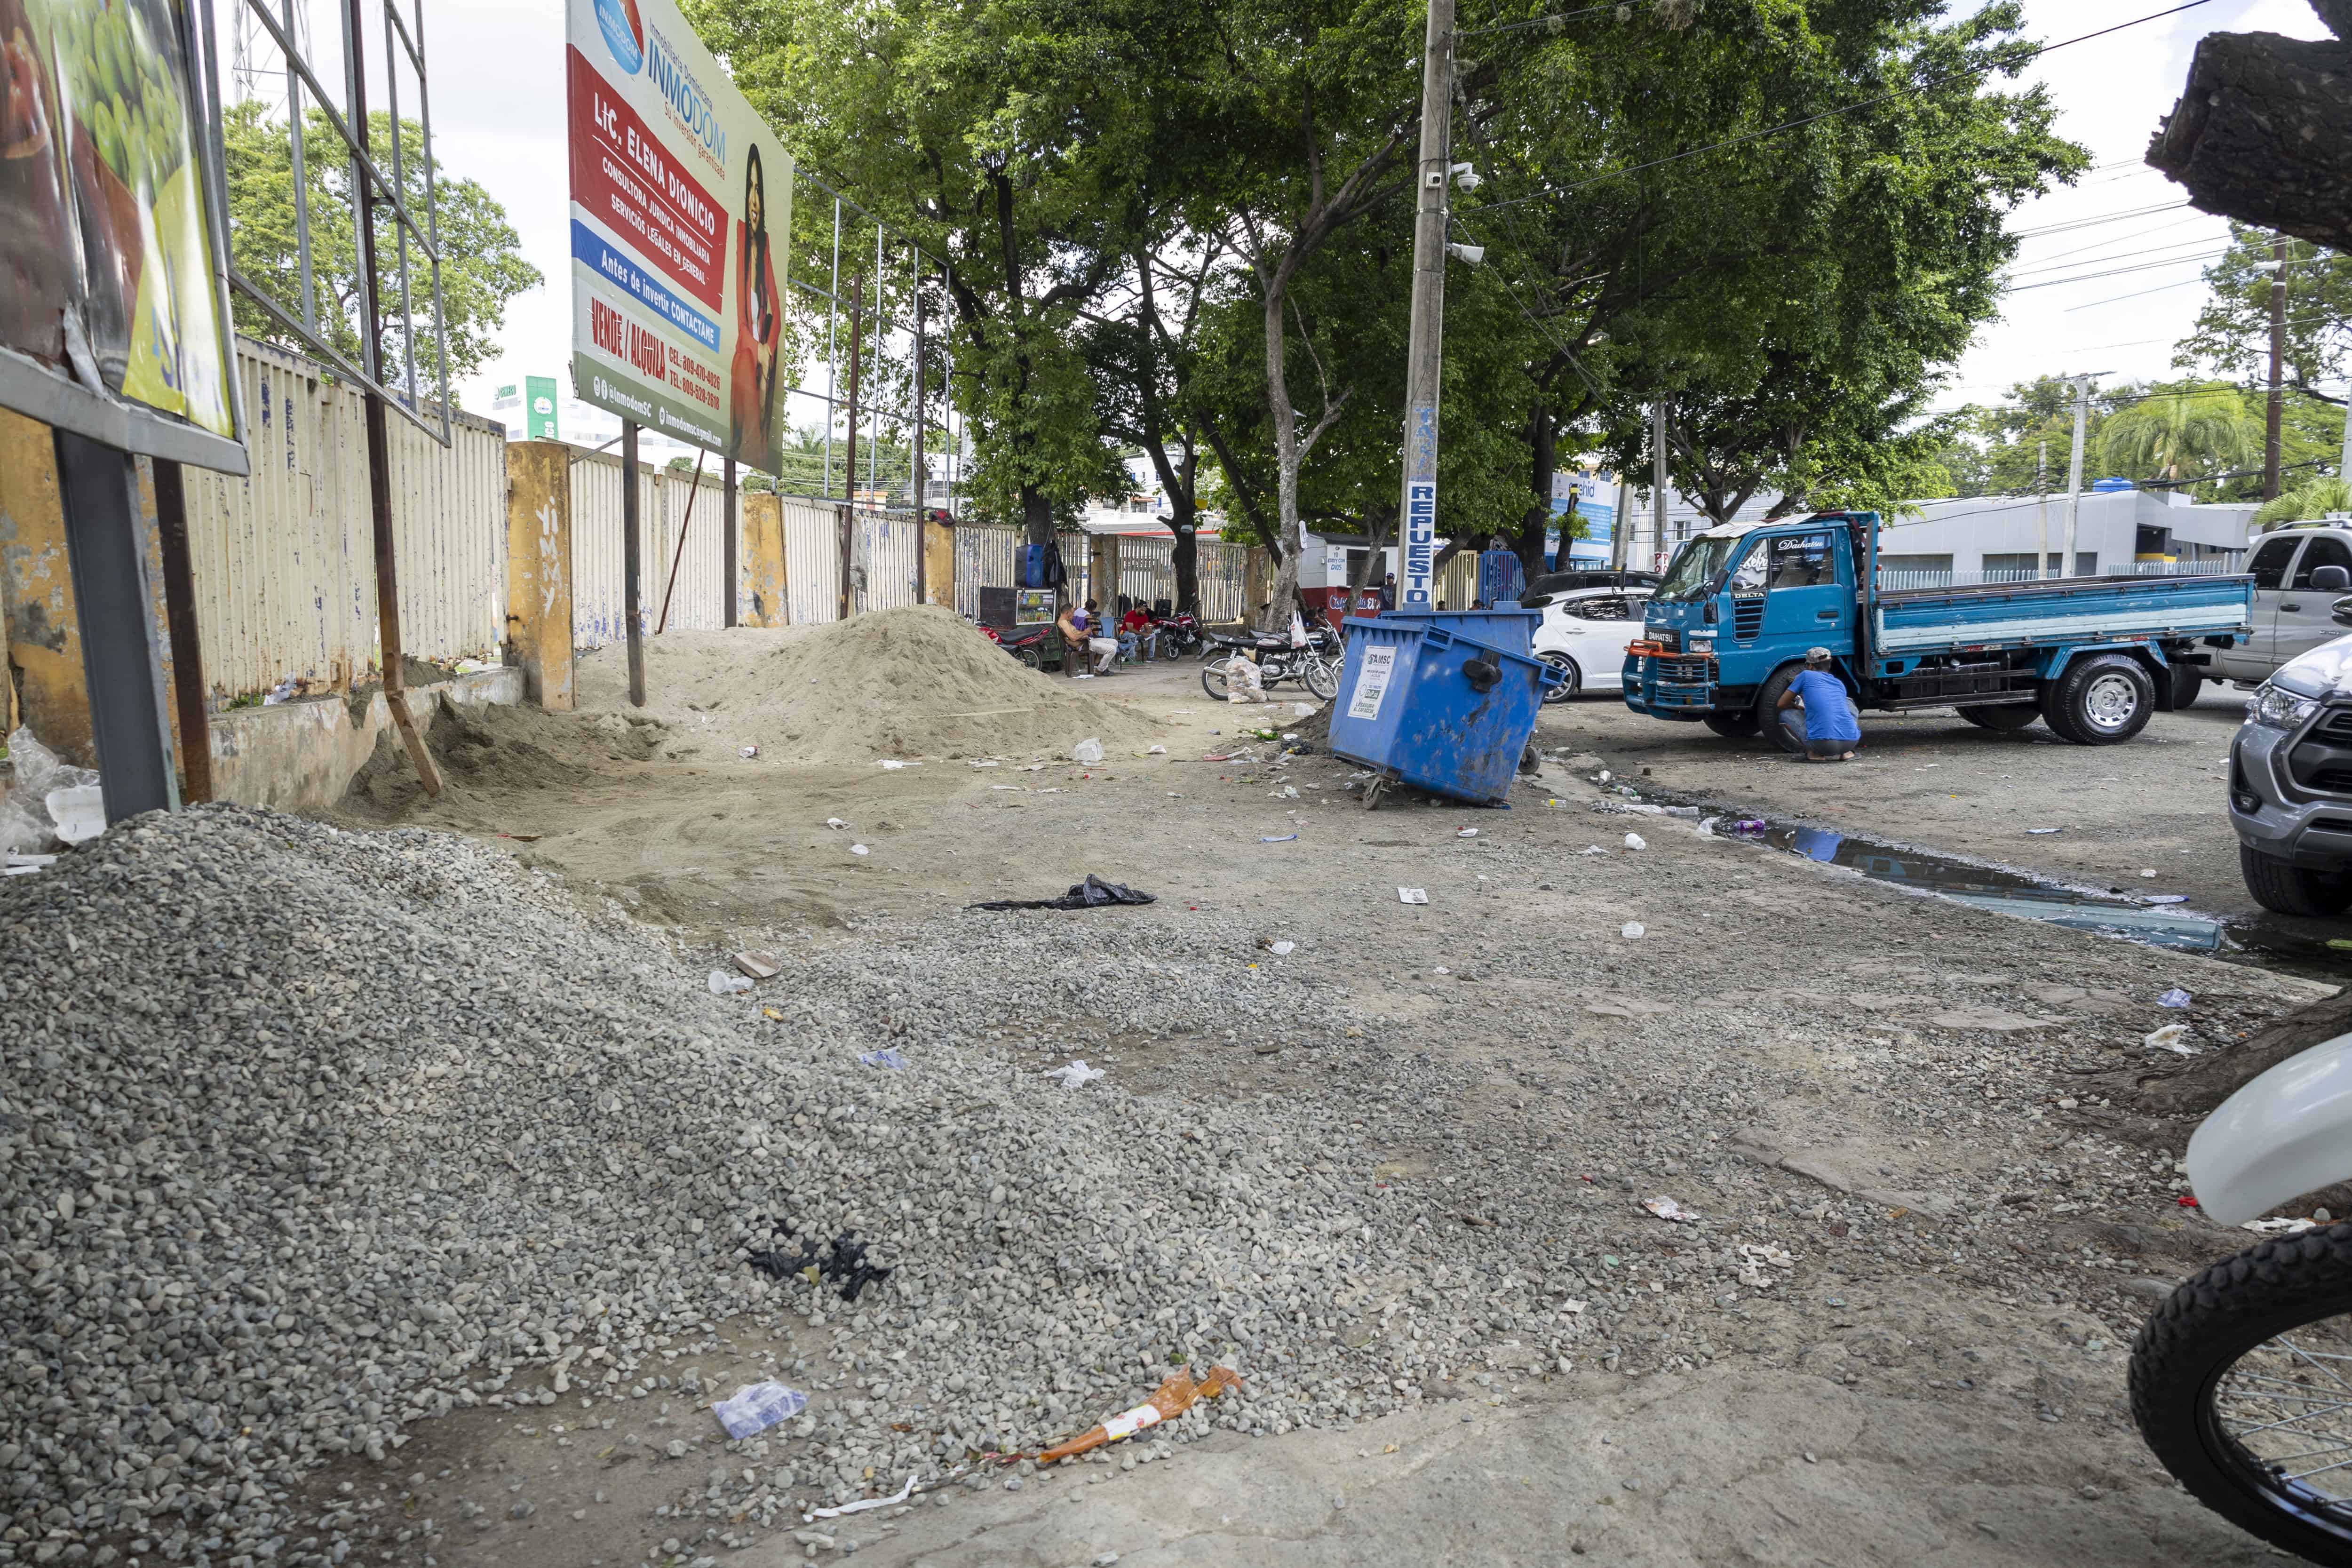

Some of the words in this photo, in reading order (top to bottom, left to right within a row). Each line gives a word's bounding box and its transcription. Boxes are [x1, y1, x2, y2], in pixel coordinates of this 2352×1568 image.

[599, 4, 638, 60] INMODOM
[650, 17, 683, 73] Inmobiliaria
[684, 64, 713, 111] Dominicana
[648, 38, 725, 166] INMODOM
[665, 101, 672, 120] Su
[698, 143, 725, 181] garantizada
[603, 157, 647, 209] CONSULTORA
[649, 200, 674, 235] JURIDICA
[676, 224, 710, 266] INMOBILIARIA
[628, 125, 665, 189] ELENA
[669, 170, 715, 236] DIONICIO
[612, 193, 645, 235] SERVICIOS
[647, 224, 672, 258] LEGALES
[674, 247, 681, 266] EN
[682, 256, 706, 286] GENERAL
[591, 296, 623, 358] VENDE
[625, 318, 629, 361] /
[631, 323, 666, 382] ALQUILA
[601, 249, 628, 284] Antes
[631, 271, 640, 293] de
[643, 279, 669, 313] invertir
[671, 301, 715, 344] CONTACTAME
[683, 355, 721, 390] 809-470-4026
[683, 377, 720, 411] 809-528-2618
[1407, 486, 1433, 603] REPUESTO
[1777, 539, 1823, 550] Daihatsu
[1648, 632, 1673, 642] DAIHATSU
